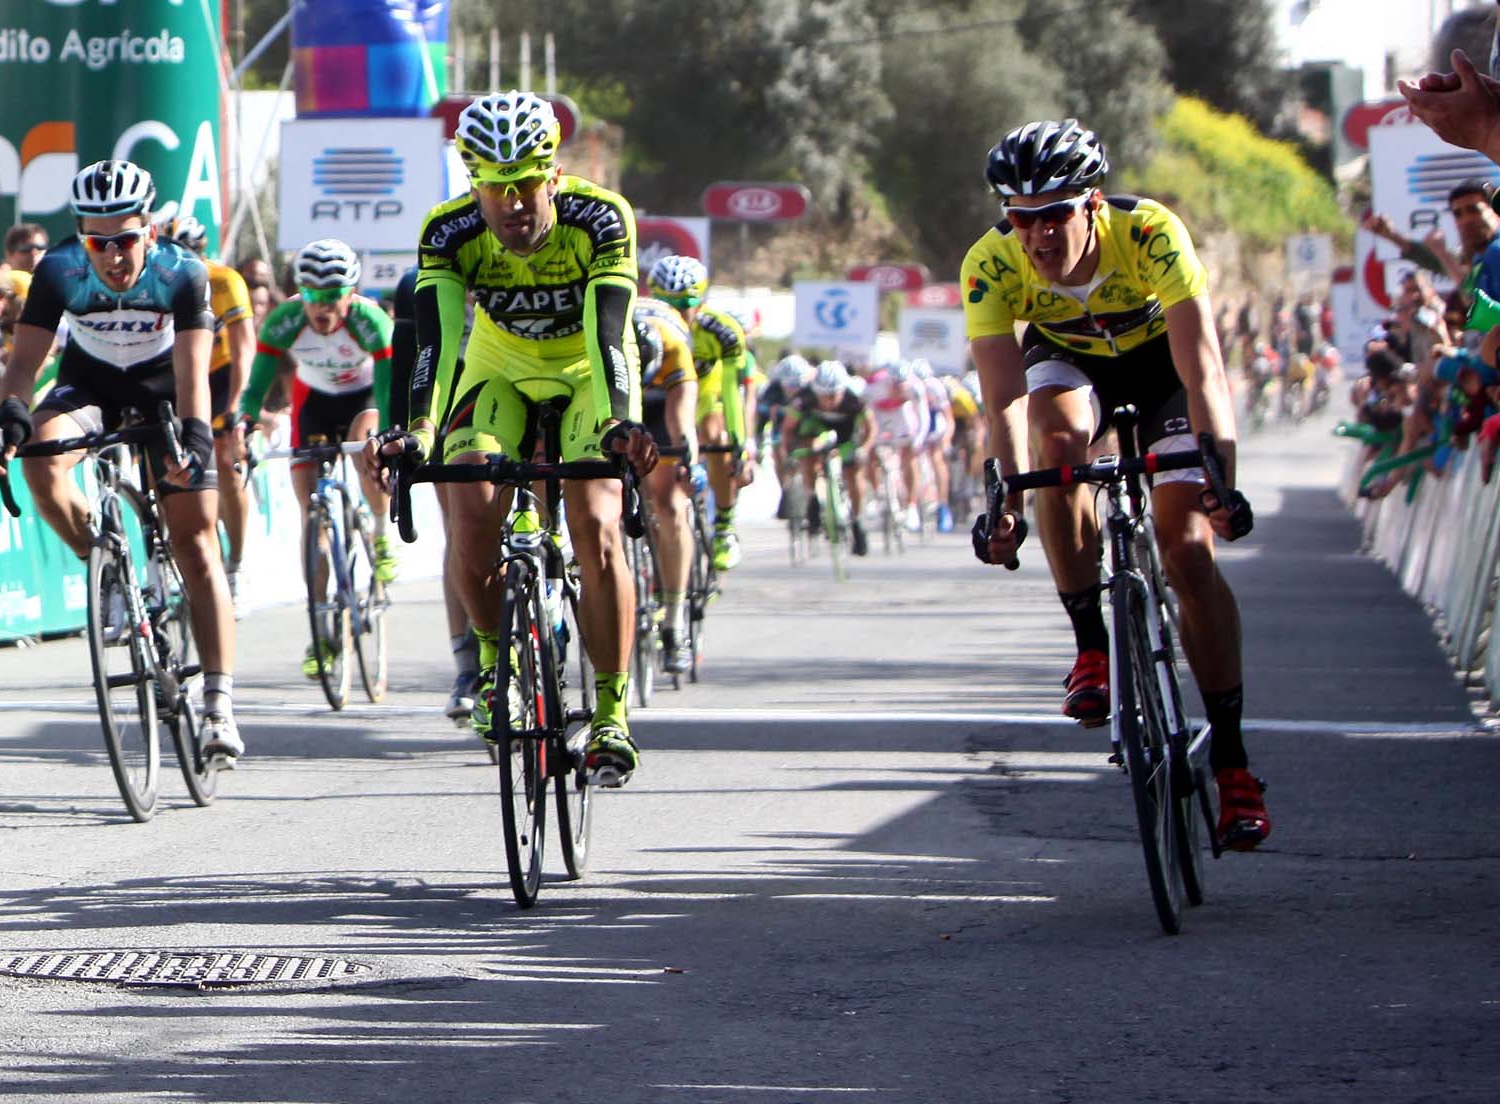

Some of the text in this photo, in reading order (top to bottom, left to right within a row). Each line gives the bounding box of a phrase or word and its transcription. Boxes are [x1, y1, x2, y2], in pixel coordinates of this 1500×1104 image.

[59, 28, 186, 69] Agrícola
[311, 201, 404, 221] RTP
[979, 254, 1017, 282] CA
[1147, 232, 1181, 277] CA
[1036, 290, 1066, 308] CA
